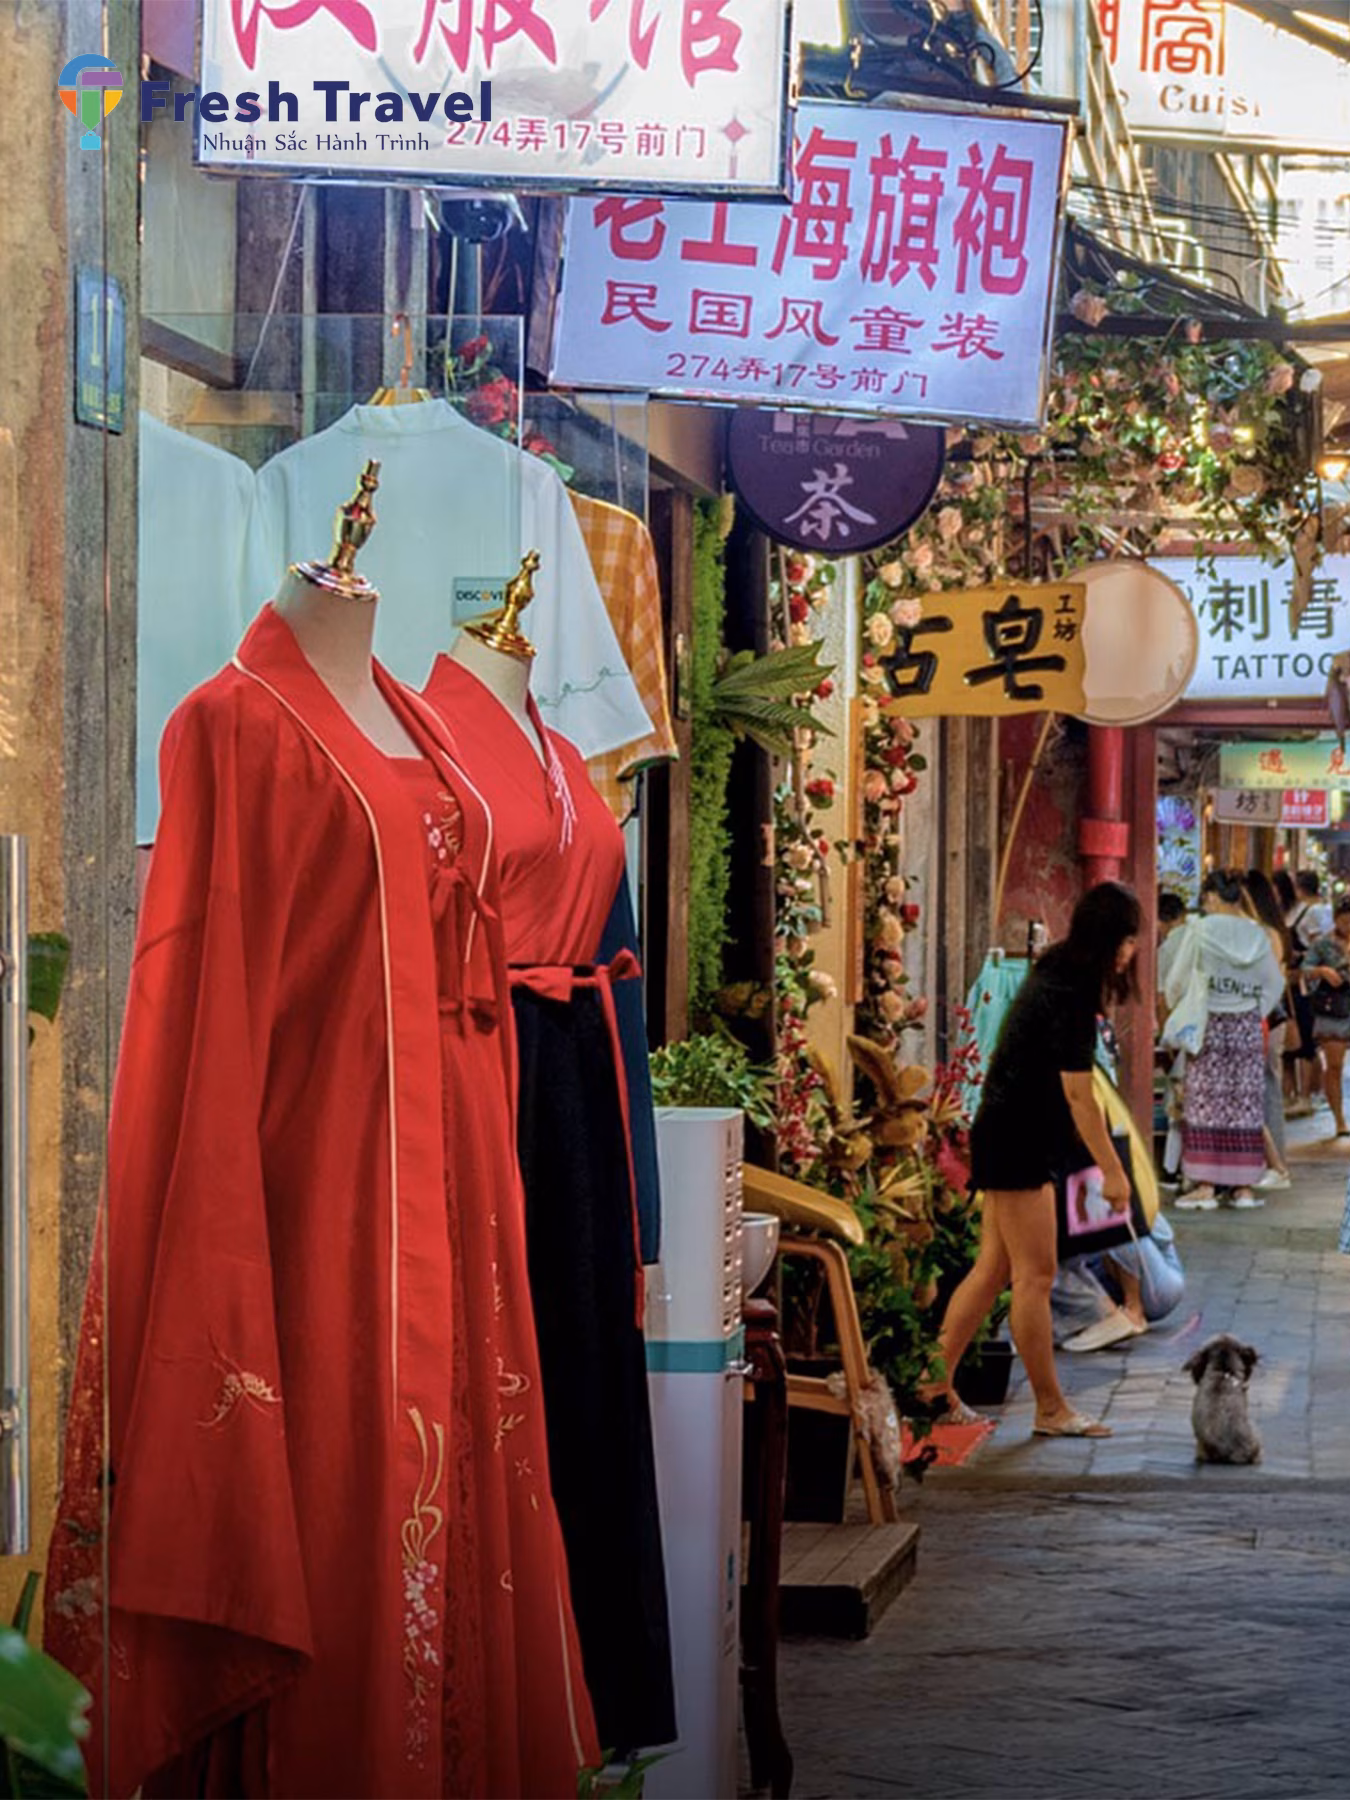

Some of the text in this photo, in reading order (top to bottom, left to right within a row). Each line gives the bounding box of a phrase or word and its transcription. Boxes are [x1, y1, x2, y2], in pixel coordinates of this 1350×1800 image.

[445, 118, 706, 159] 274弄17号前门
[600, 280, 1005, 361] 民国风童装
[666, 353, 928, 398] 274弄17号前门
[759, 436, 880, 459] Tea Garden
[782, 462, 878, 541] 茶
[1053, 593, 1079, 642] 工坊
[1208, 577, 1342, 643] 刺青
